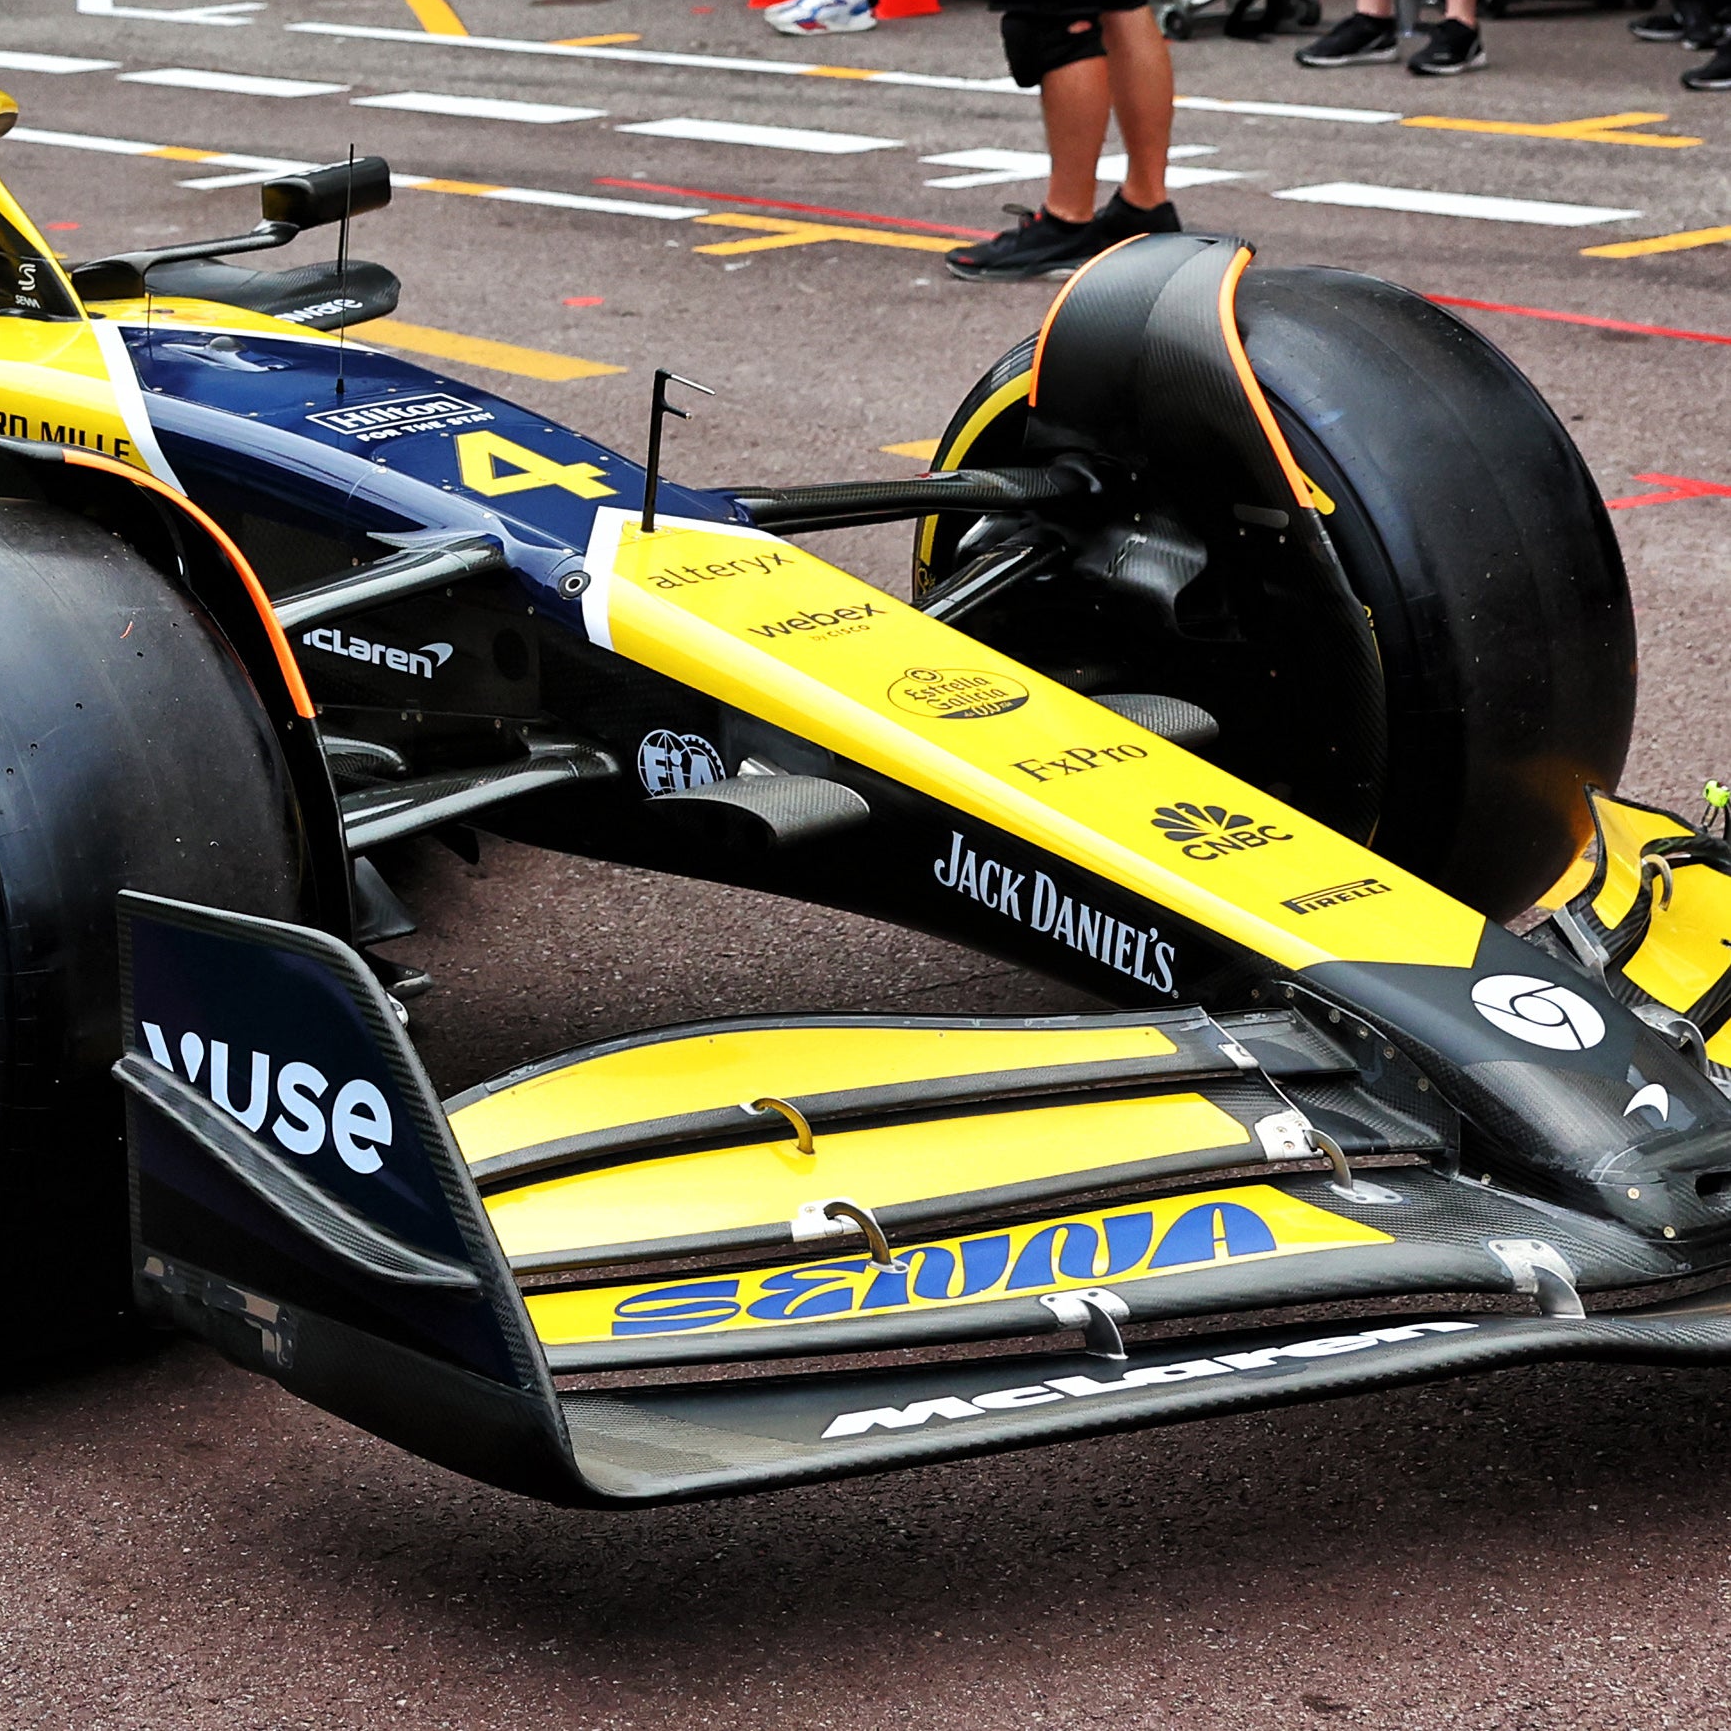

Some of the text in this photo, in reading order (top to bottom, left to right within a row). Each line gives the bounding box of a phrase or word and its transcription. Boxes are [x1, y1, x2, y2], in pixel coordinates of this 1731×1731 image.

[326, 399, 463, 430] Hilton
[356, 412, 495, 442] FOR THE STAY
[454, 430, 620, 500] 4
[647, 552, 795, 589] alteryx
[747, 603, 888, 639] webex
[904, 675, 992, 701] Estrella
[926, 687, 1009, 711] Galicia
[1008, 744, 1148, 783] FxPro
[1181, 825, 1294, 861] CNBC
[934, 830, 1175, 993] JACK DANIEL'S
[1279, 878, 1393, 915] PIRELLI
[611, 1201, 1277, 1337] SENNA
[821, 1320, 1479, 1440] McLaren
